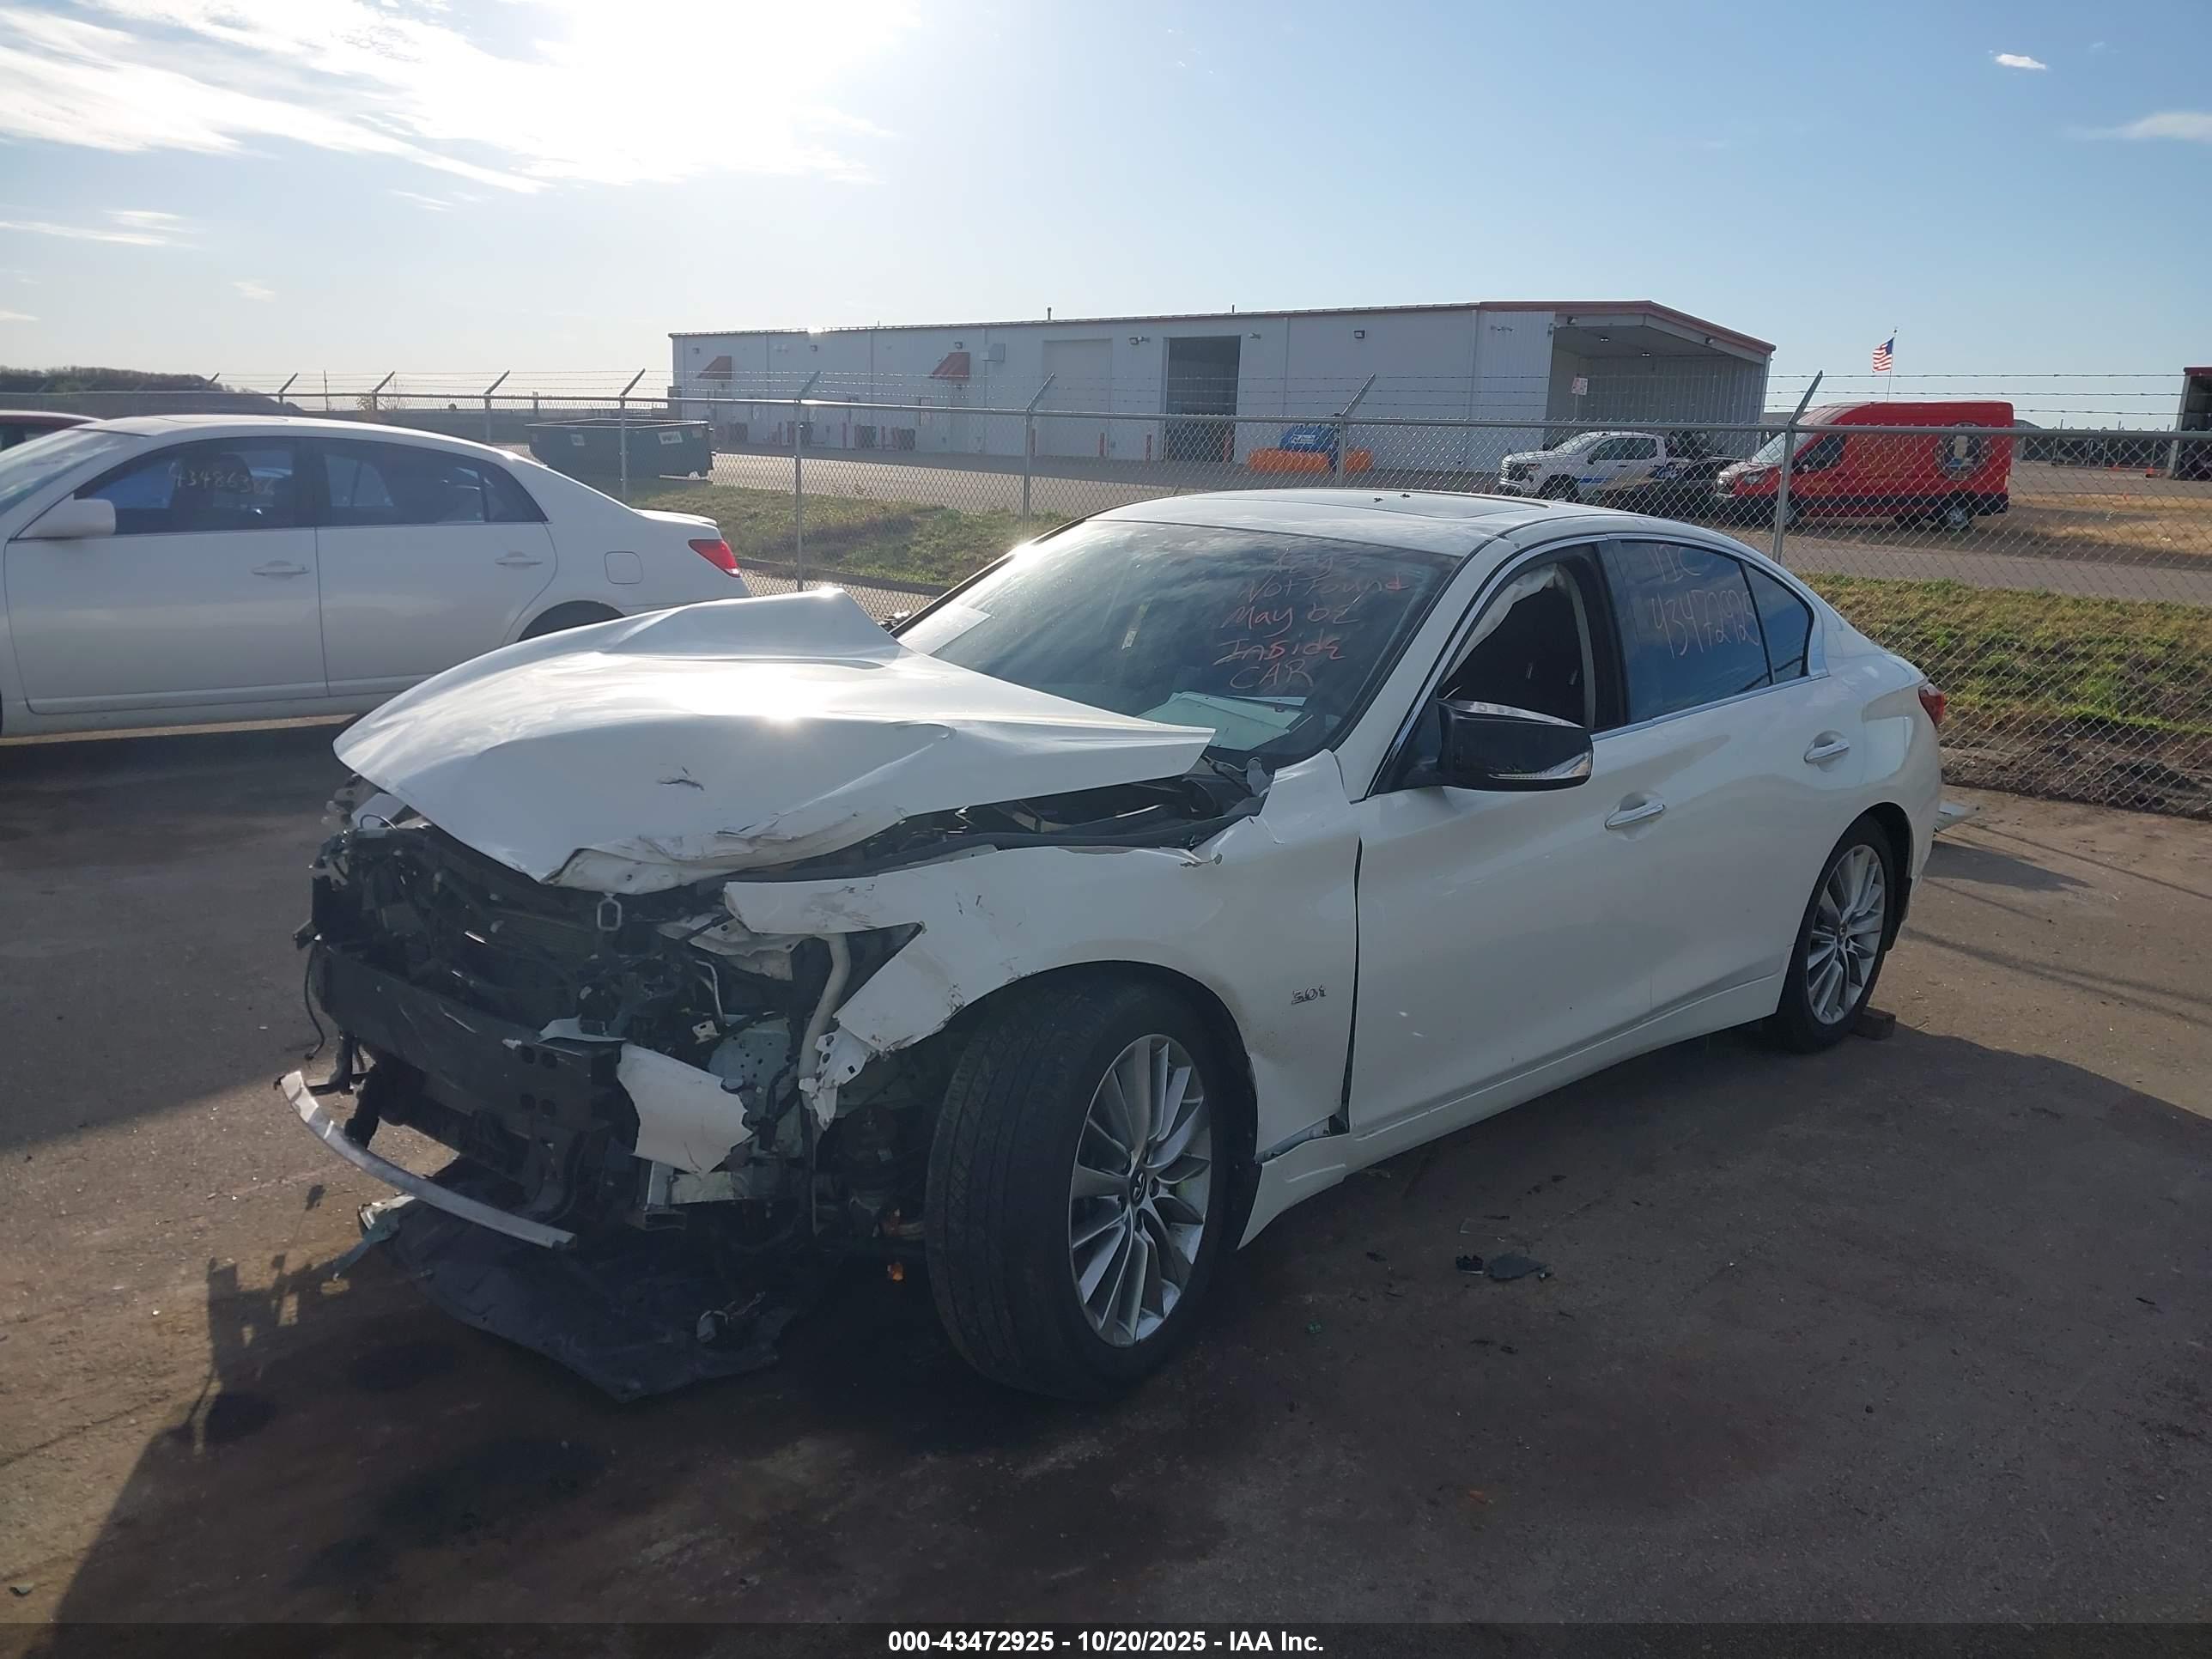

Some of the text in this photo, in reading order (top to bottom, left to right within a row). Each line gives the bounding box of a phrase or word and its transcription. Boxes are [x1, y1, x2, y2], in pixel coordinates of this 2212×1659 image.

[1237, 570, 1410, 604] Not Found
[1219, 604, 1294, 639] May
[1212, 628, 1346, 666] Inside
[1229, 658, 1315, 690] CAR
